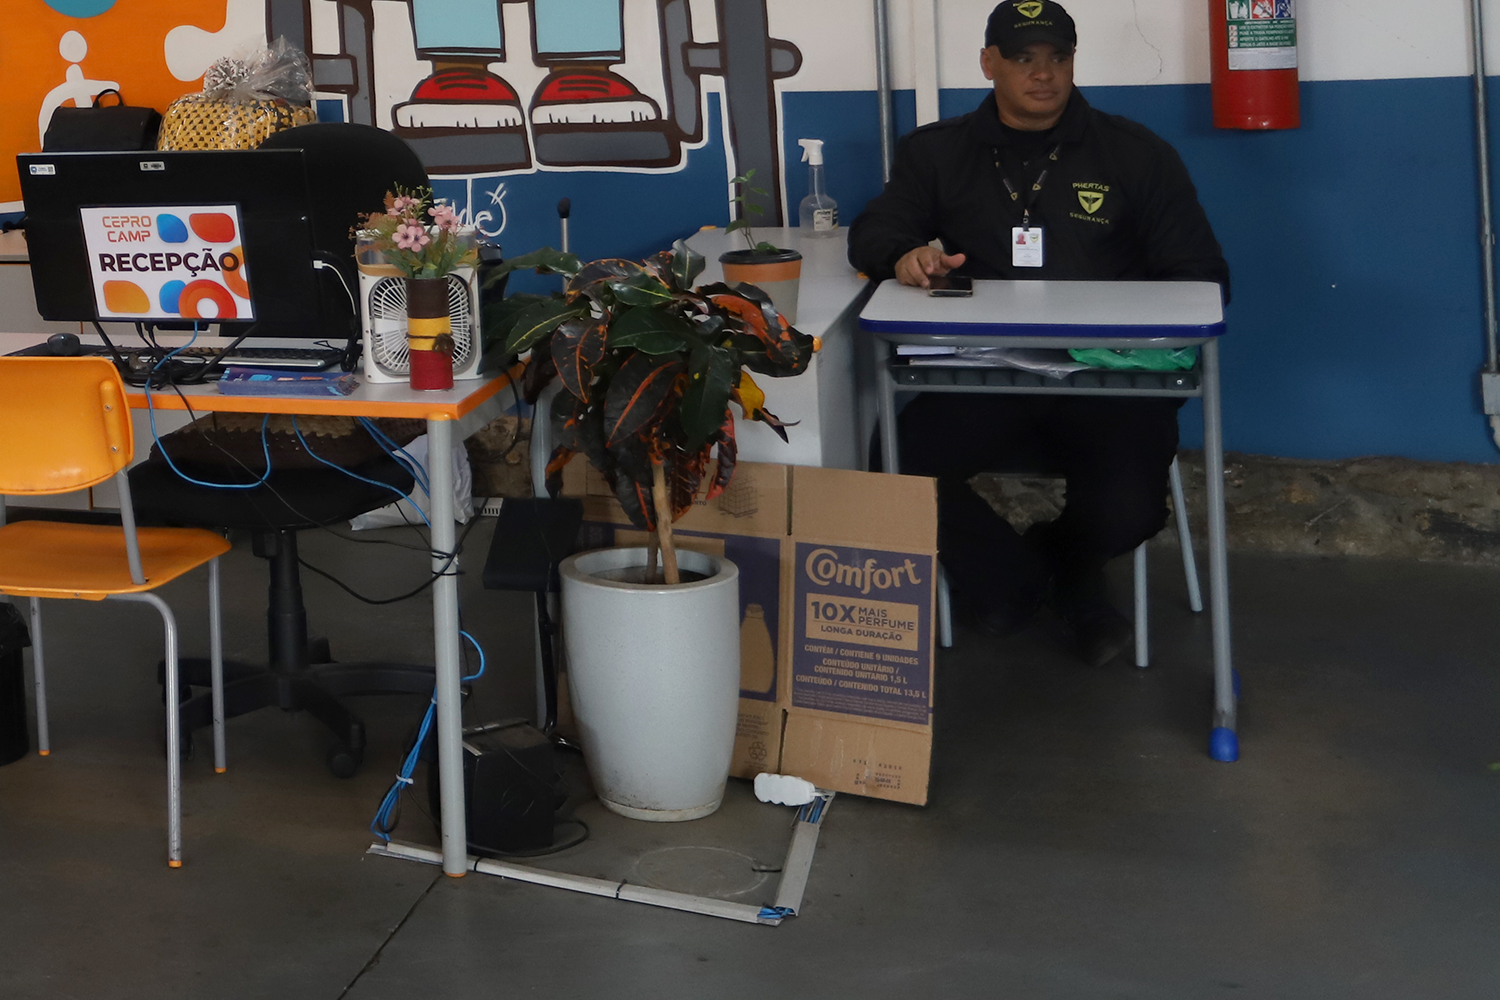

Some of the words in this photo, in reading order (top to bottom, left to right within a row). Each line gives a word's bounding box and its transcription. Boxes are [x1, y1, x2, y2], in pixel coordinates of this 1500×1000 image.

[1072, 182, 1110, 192] PHERTAS
[102, 215, 152, 228] CEPRO
[1070, 212, 1109, 224] SEGURANÇA
[107, 230, 151, 242] CAMP
[99, 248, 239, 277] RECEPÇÃO
[805, 548, 921, 594] Comfort
[811, 601, 856, 623] 10X
[859, 607, 887, 618] MAIS
[859, 616, 914, 631] PERFUME
[821, 625, 853, 635] LONGA
[856, 629, 902, 641] DURAÇÃO
[804, 644, 834, 654] CONTÉM
[840, 648, 874, 660] CONTIENE
[882, 654, 918, 665] UNIDADES
[822, 658, 859, 669] CONTEÚDO
[861, 663, 894, 674] UNITÁRIO
[814, 665, 853, 677] CONTENIDO
[855, 670, 888, 681] UNITARIO
[890, 675, 901, 684] 1,5
[796, 674, 832, 686] CONTEÚDO
[839, 680, 878, 692] CONTENIDO
[880, 686, 902, 695] TOTAL
[904, 689, 920, 698] 13,5
